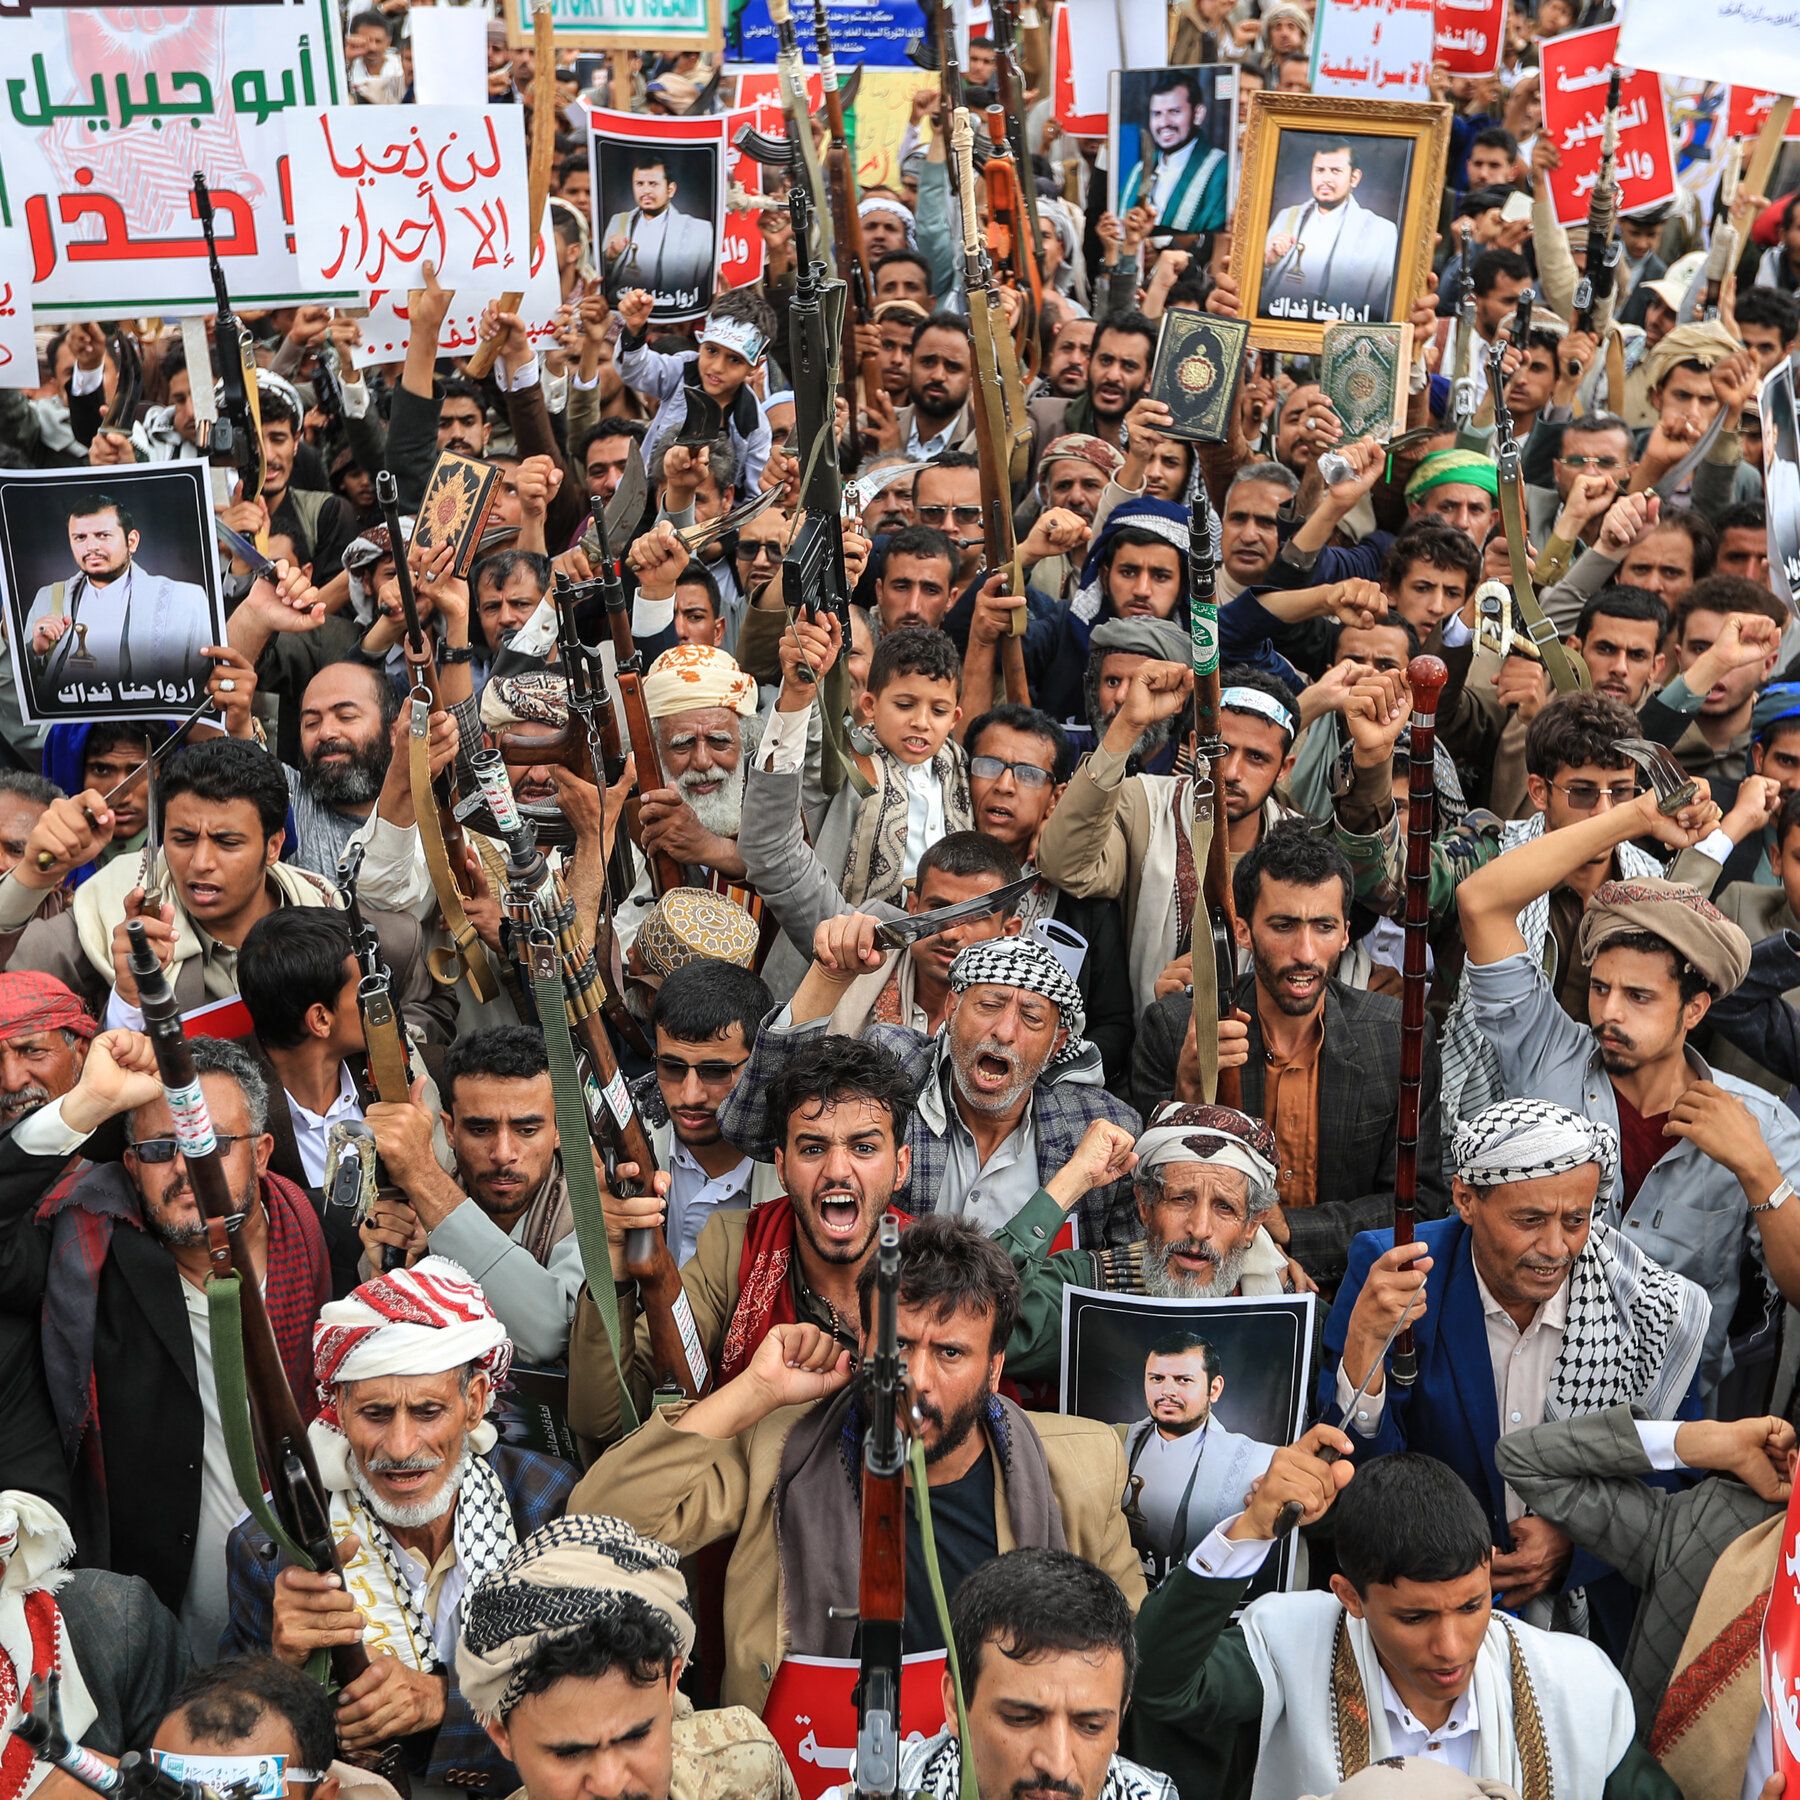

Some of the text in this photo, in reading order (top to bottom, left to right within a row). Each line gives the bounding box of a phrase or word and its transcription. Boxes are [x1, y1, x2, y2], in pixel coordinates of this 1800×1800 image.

[6, 53, 214, 132] جبريل
[319, 113, 501, 193] لن نحيا
[321, 180, 515, 284] إلا أحرار
[1268, 297, 1310, 319] فداك
[57, 677, 196, 705] ارواحنا فداك
